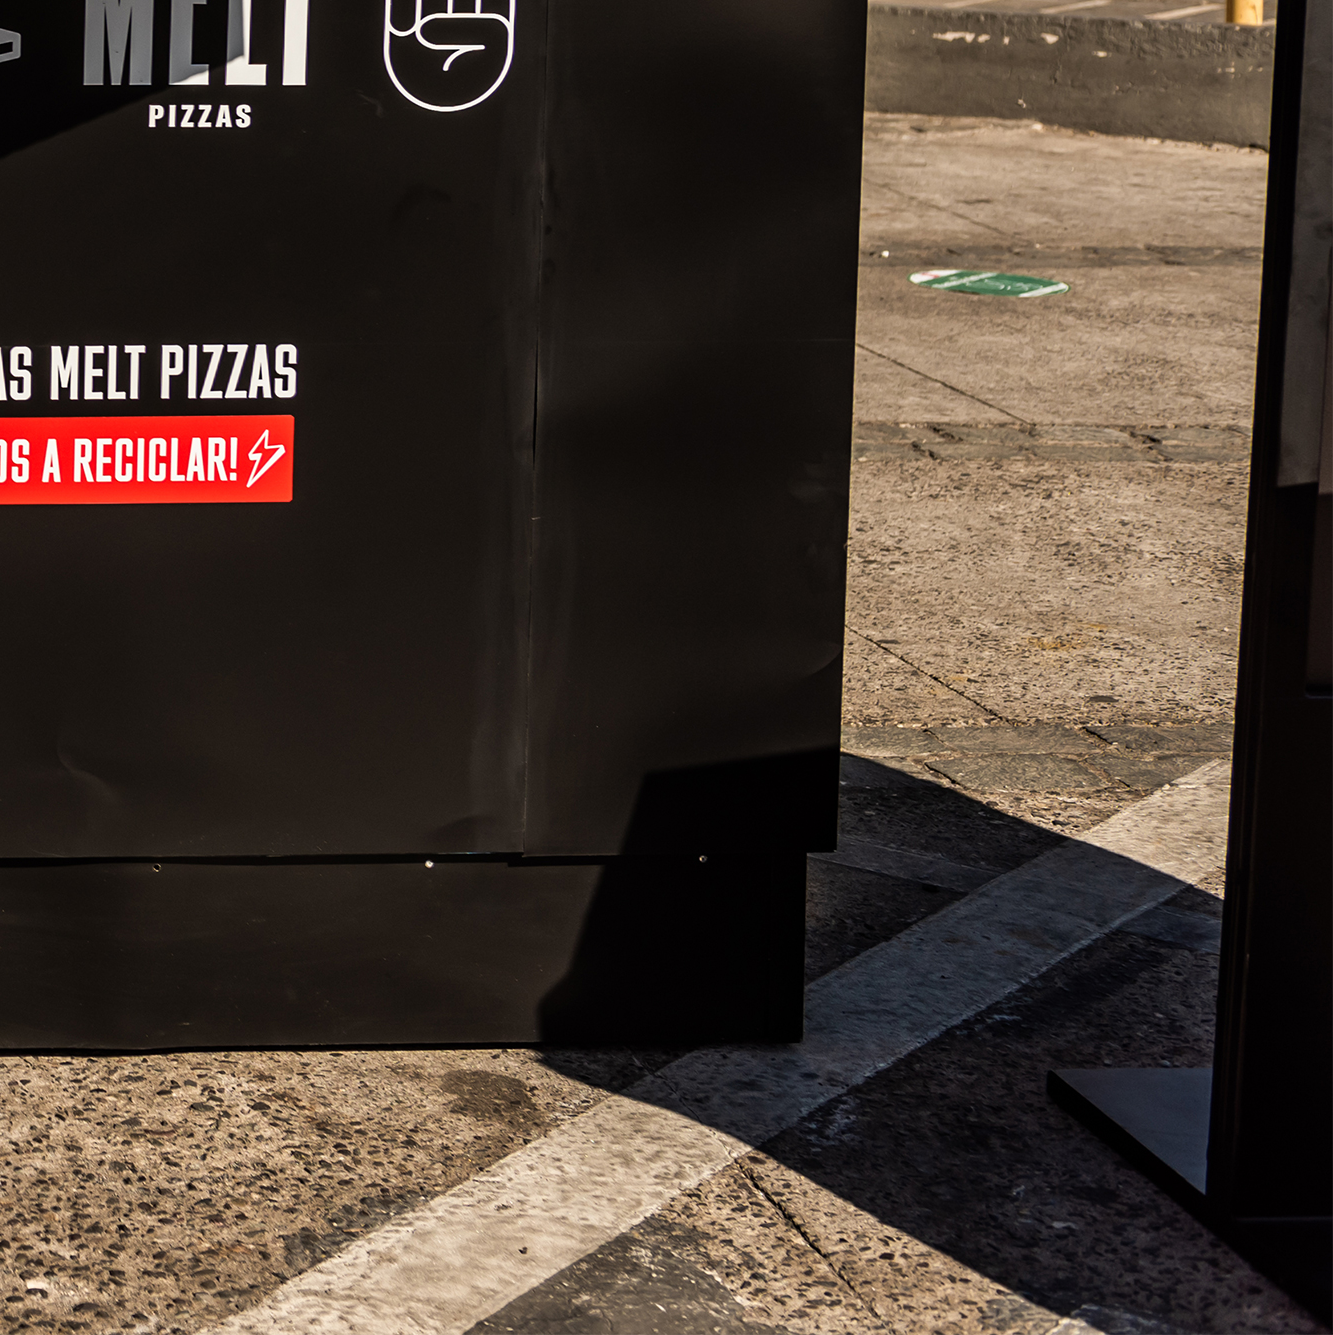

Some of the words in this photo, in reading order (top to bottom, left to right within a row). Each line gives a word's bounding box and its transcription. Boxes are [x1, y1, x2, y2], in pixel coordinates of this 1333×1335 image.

[148, 104, 252, 128] PIZZAS
[50, 344, 146, 401] MELT
[160, 343, 298, 400] PIZZAS
[41, 438, 61, 483] A
[73, 436, 239, 483] RECICLAR!
